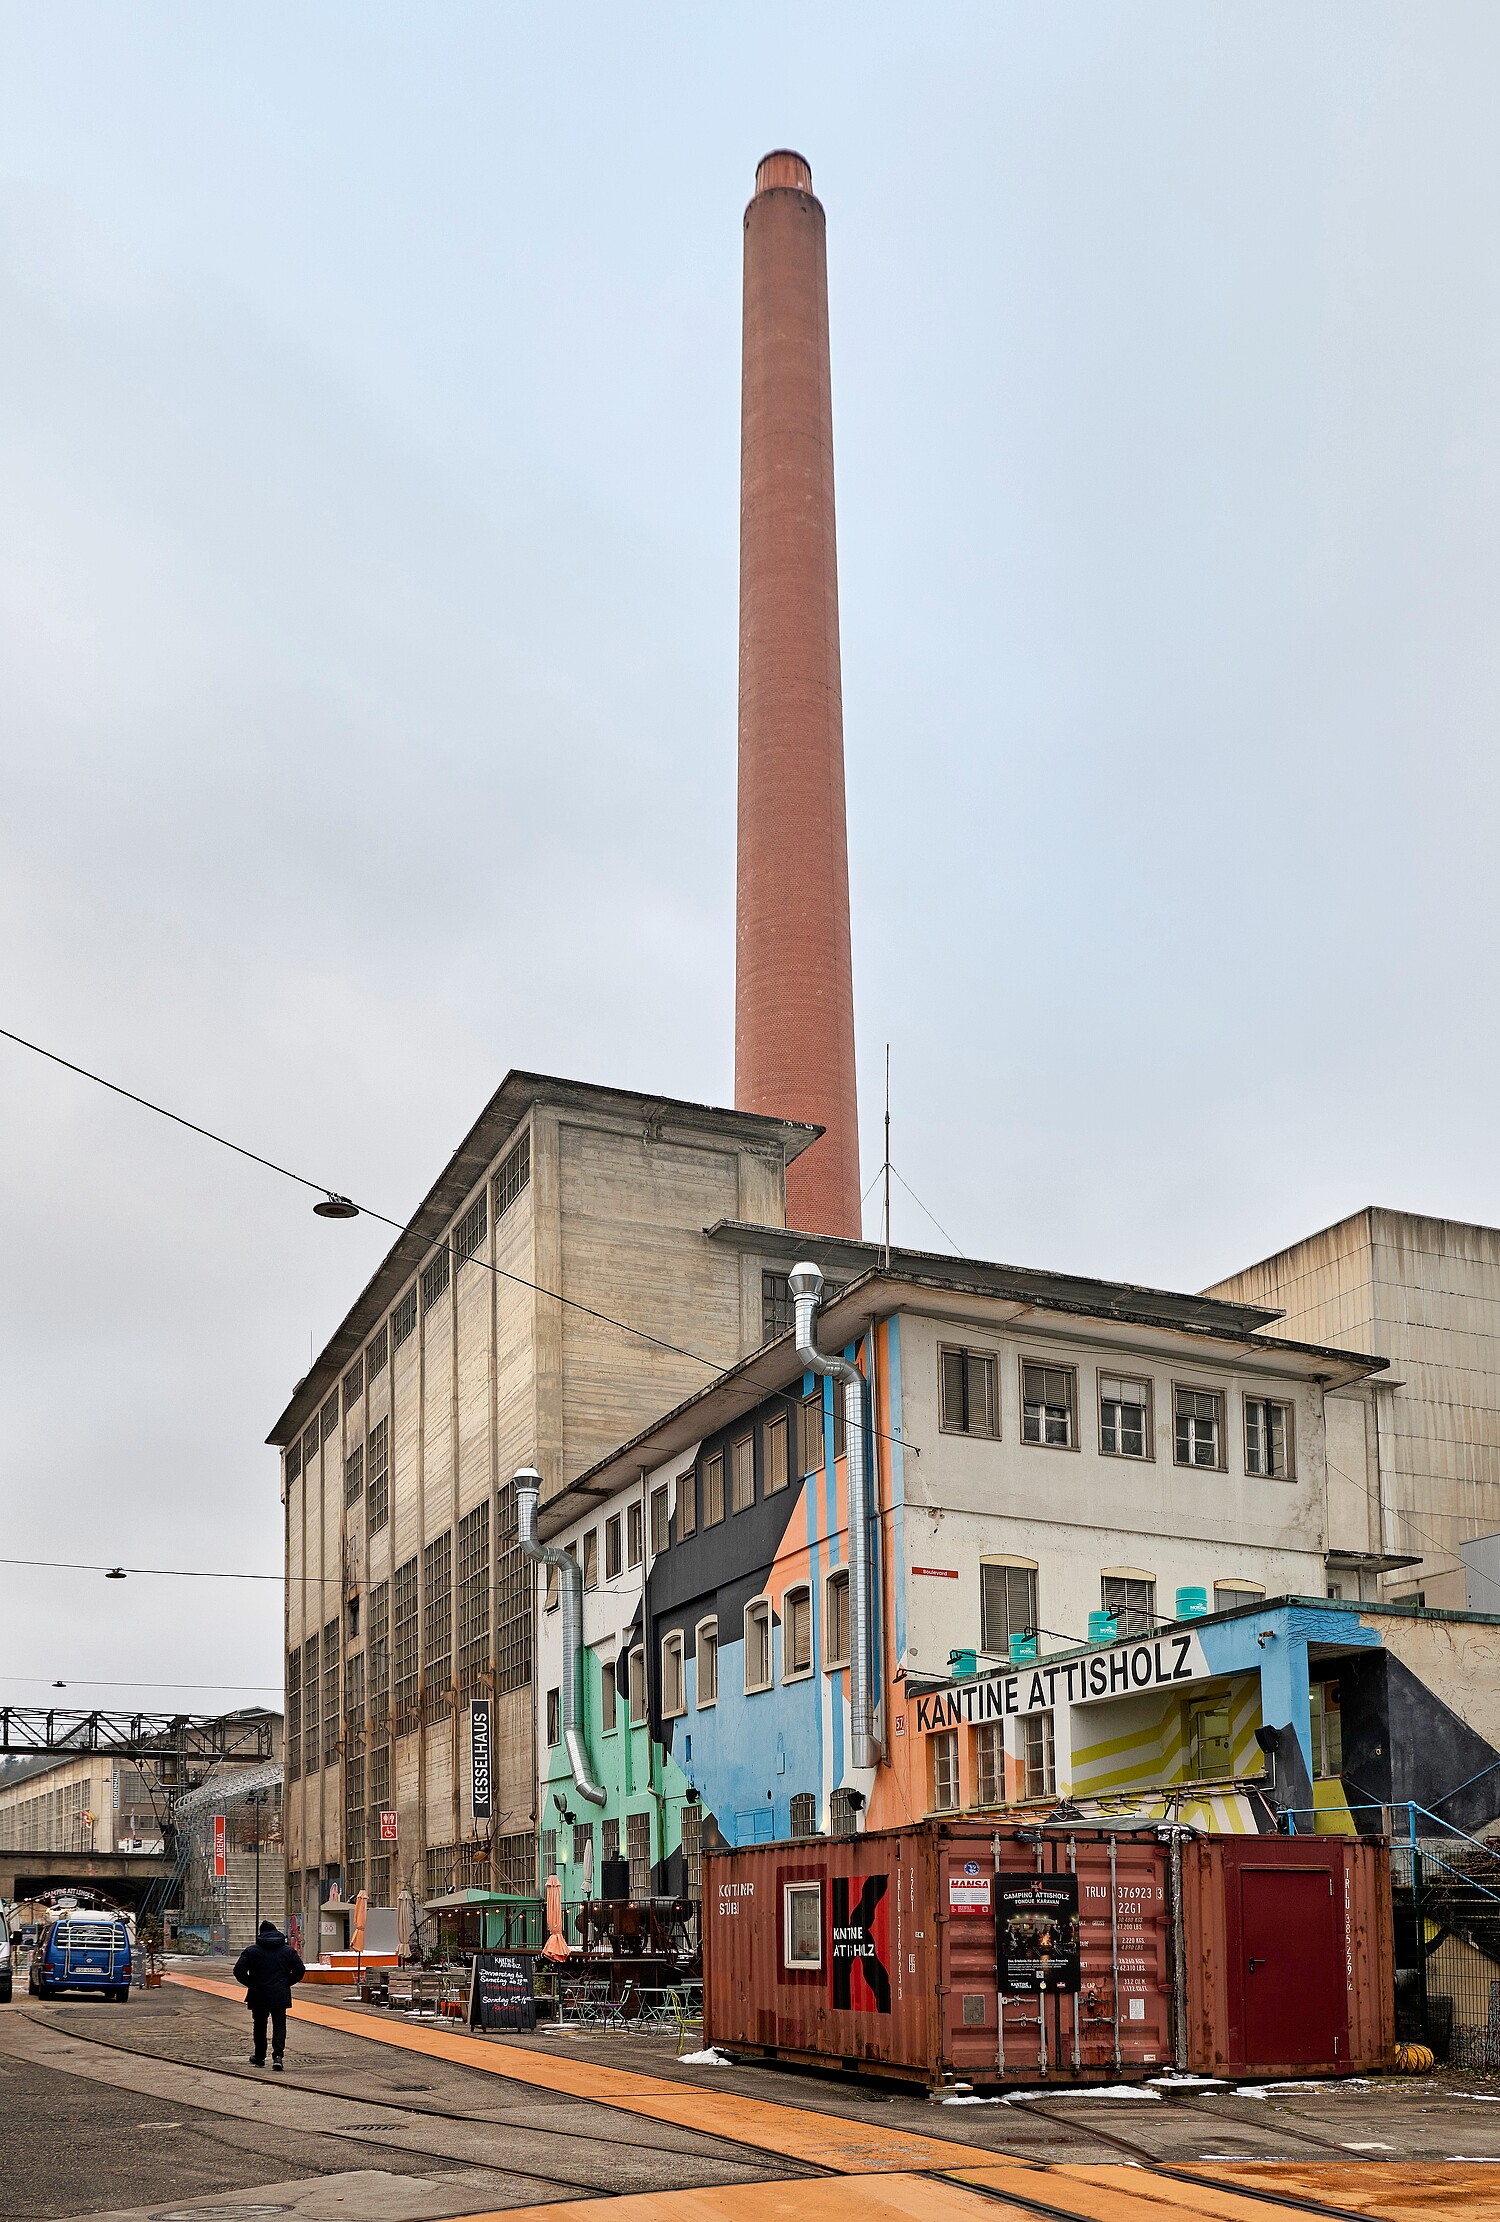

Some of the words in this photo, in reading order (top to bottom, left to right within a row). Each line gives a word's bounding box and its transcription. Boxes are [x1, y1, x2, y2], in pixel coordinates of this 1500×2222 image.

[916, 1676, 1018, 1732] KANTINE
[1028, 1634, 1192, 1710] ATTISHOLZ
[896, 1717, 903, 1729] 57
[474, 1712, 488, 1804] KESSELHAUS
[1036, 1892, 1070, 1900] ATTISHOLZ
[1085, 1886, 1106, 1898] TRLU
[1118, 1887, 1152, 1898] 376923
[1157, 1888, 1163, 1899] 3
[1118, 1903, 1141, 1913] 22G1
